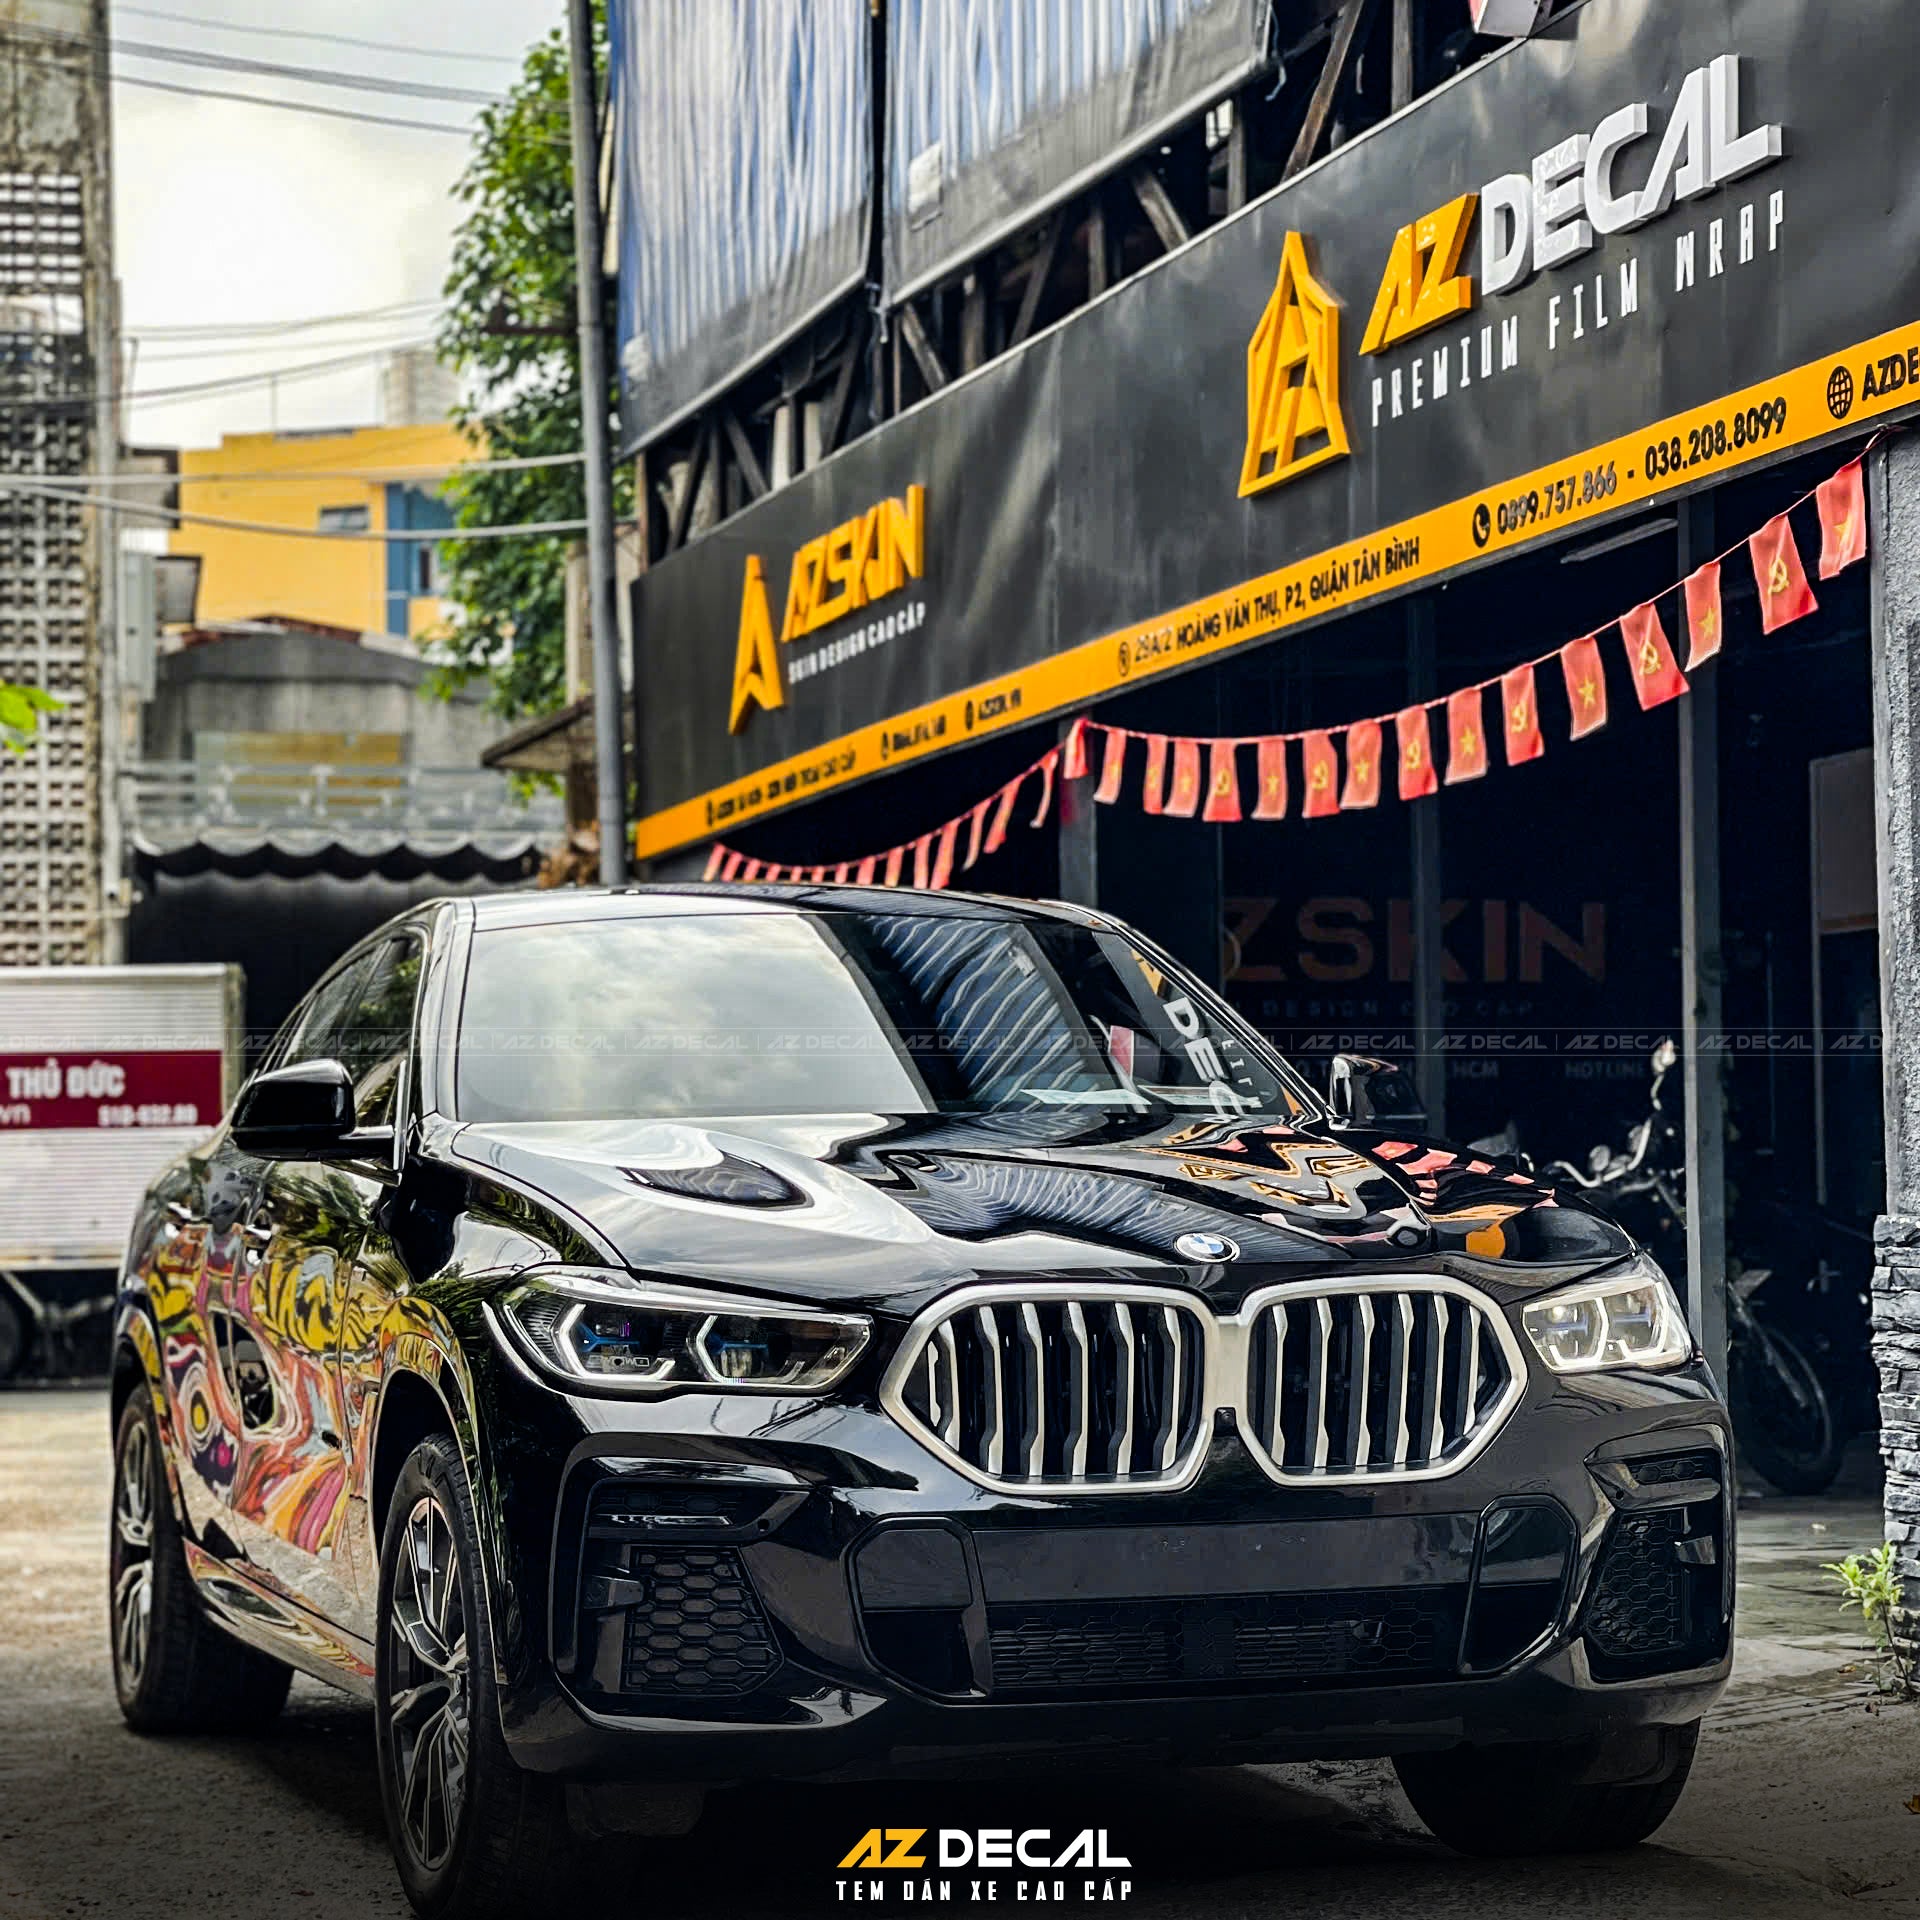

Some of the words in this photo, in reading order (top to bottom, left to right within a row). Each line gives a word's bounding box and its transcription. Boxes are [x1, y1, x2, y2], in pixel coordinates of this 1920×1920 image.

[1360, 192, 1479, 356] AZ
[1480, 55, 1783, 296] DECAL
[1371, 315, 1518, 428] PREMIUM
[1548, 258, 1638, 350] FILM
[1676, 190, 1785, 292] WRAP
[1862, 346, 1920, 401] AZDE
[1497, 461, 1617, 535] 0899.757.866
[1645, 396, 1787, 480] 038.208.8099
[781, 483, 925, 645] AZSKIN
[1177, 613, 1221, 650] HOÀNG
[1225, 597, 1250, 634] VĂN
[1309, 560, 1349, 602] QUẬN
[1353, 549, 1380, 587] TÂN
[1385, 536, 1420, 575] BÌNH
[5, 1057, 63, 1099] THỦ
[66, 1059, 126, 1098] ĐỨC
